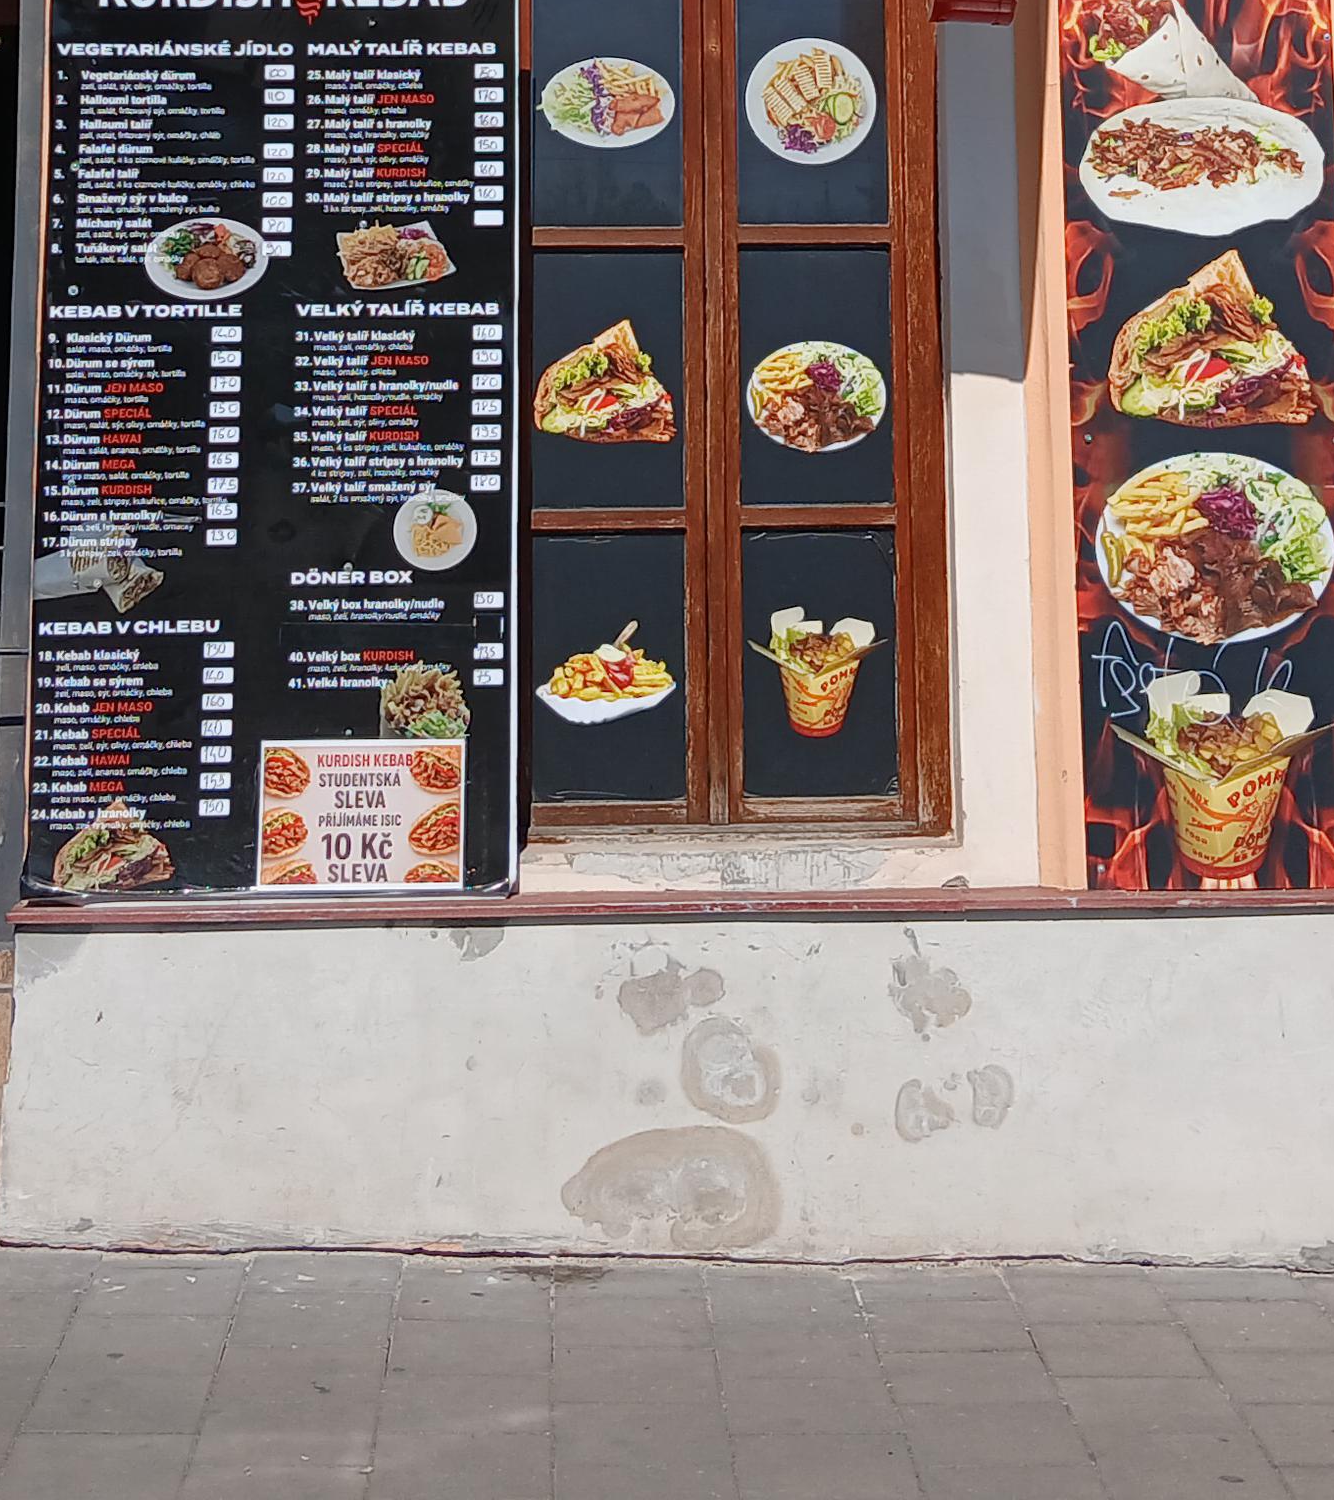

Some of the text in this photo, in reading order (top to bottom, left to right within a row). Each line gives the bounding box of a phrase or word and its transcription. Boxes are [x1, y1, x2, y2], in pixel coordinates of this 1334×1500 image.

[56, 39, 294, 57] VEGETARIÁNSKÉ JÍDLO
[307, 39, 497, 56] MALÝ TALÍŘ KEBAB
[377, 94, 399, 104] JEN
[400, 94, 435, 104] MASO
[377, 142, 423, 154] SPECIÁL
[376, 168, 426, 178] KURDISH
[49, 304, 243, 319] KEBAB V TORTILLE
[296, 300, 500, 316] VELKÝ TALÍŘ KEBAB
[370, 355, 392, 366] JEN
[395, 355, 429, 365] MASO
[104, 382, 164, 393] JEN MASO
[103, 407, 152, 418] SPECIÁL
[370, 404, 417, 416] SPECIÁL
[369, 430, 419, 441] KURDISH
[101, 459, 136, 470] MEGA
[101, 485, 152, 495] KURDISH
[291, 568, 414, 585] DÖNER BOX
[341, 599, 361, 609] box
[38, 620, 221, 635] KEBAB V CHLEBU
[341, 650, 414, 661] box KURDISH
[92, 702, 153, 713] JEN MASO
[91, 727, 141, 739] SPECIÁL
[317, 754, 413, 768] KURDISH KEBAB
[319, 770, 401, 787] STUDENTSKÁ
[89, 782, 124, 792] MEGA
[334, 790, 386, 809] SLEVA
[380, 814, 402, 826] ISIC
[321, 831, 393, 860] 10 Kč
[327, 863, 388, 883] SLEVA
